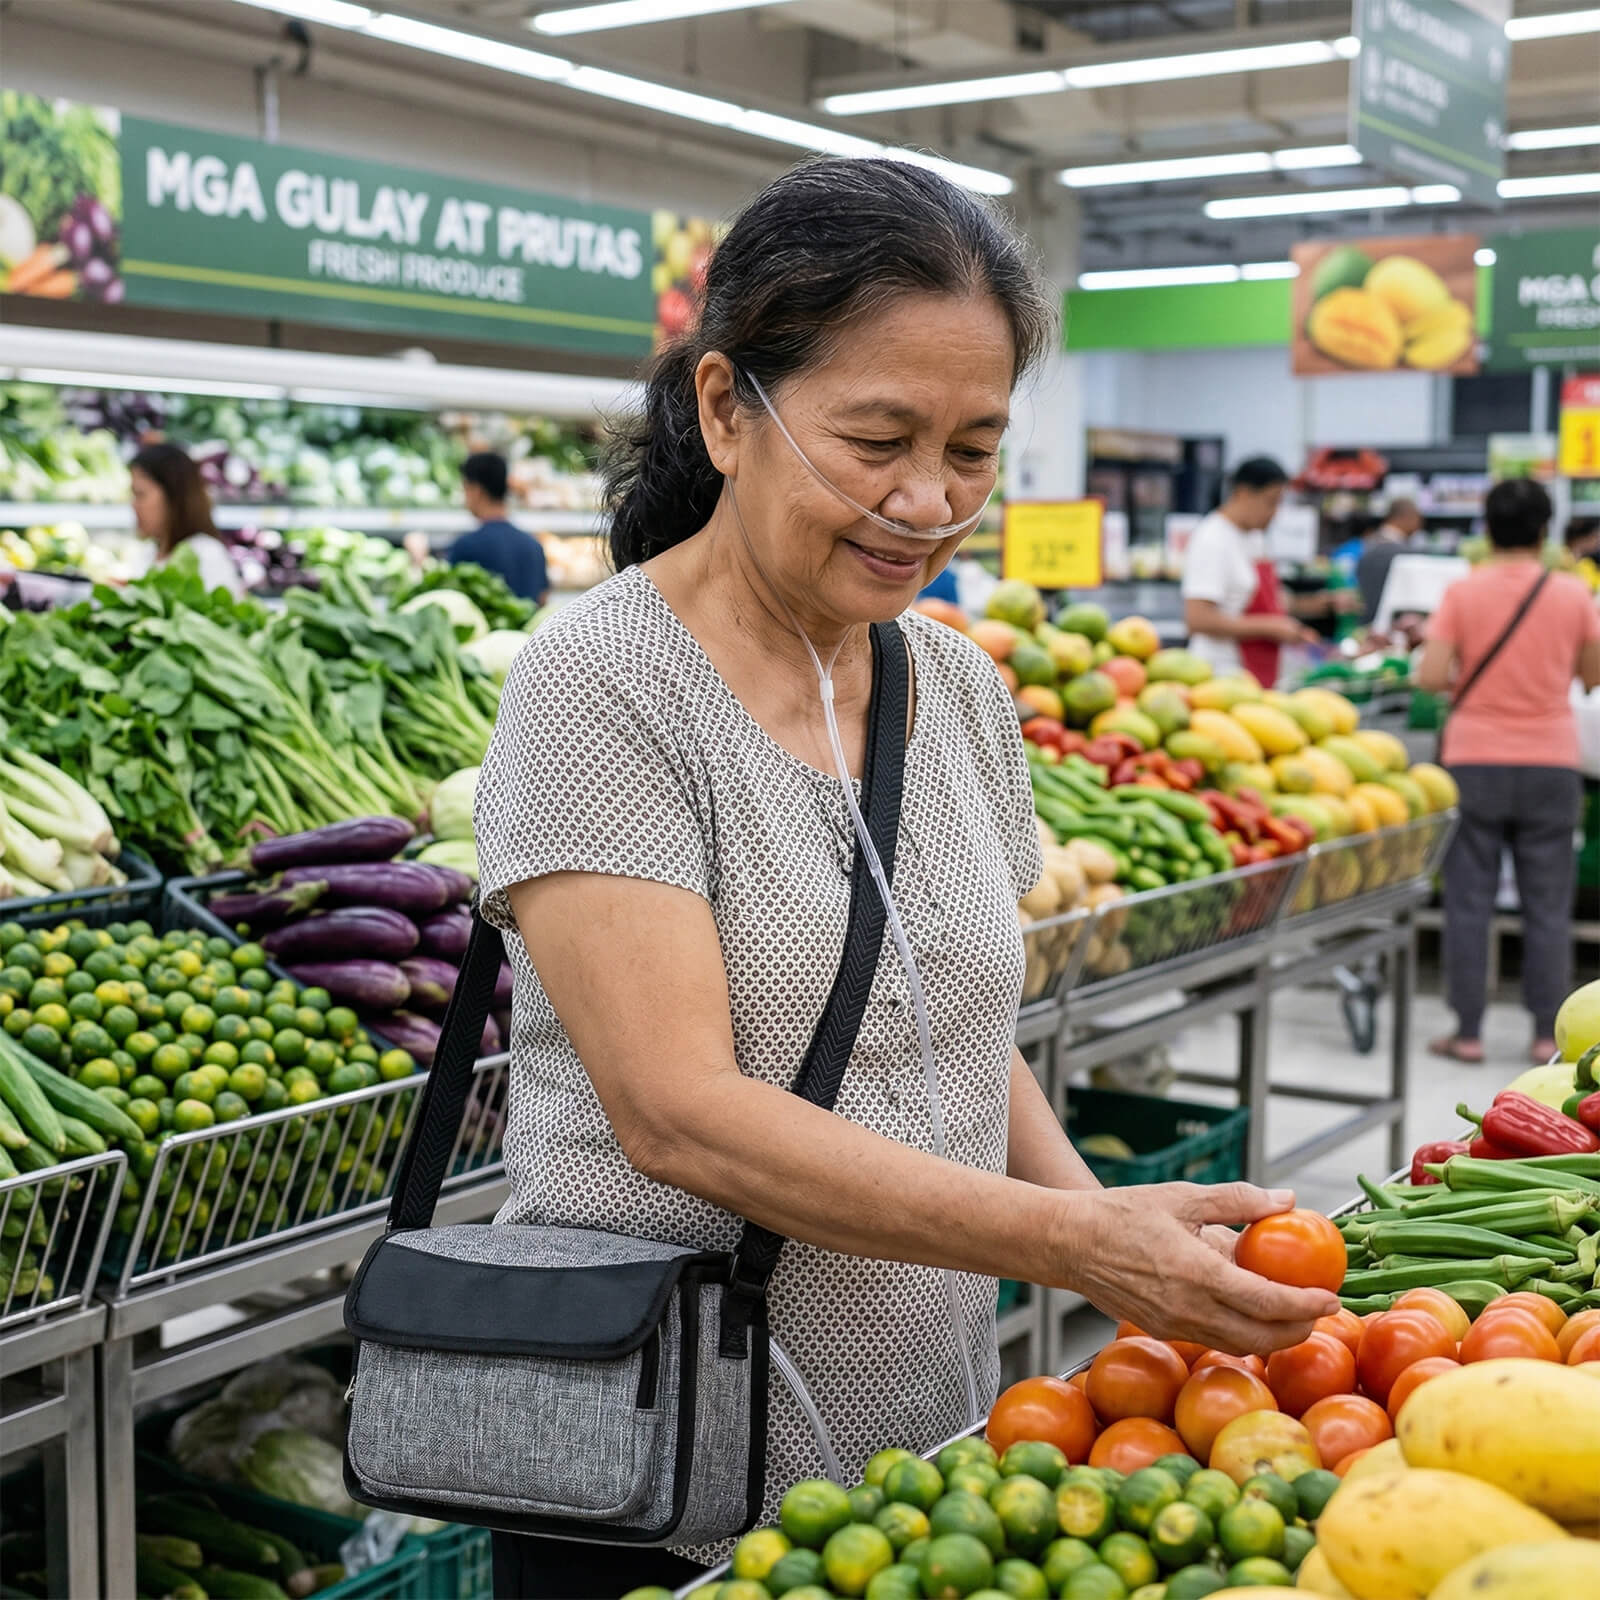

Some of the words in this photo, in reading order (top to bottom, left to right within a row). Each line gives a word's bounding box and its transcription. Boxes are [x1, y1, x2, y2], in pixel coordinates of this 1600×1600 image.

[147, 147, 267, 223] MGA
[275, 169, 429, 245] GULAY
[434, 197, 492, 257] AT
[498, 206, 643, 280] PRUTAS
[308, 238, 399, 286] FRESH
[401, 252, 526, 304] PRODUCE
